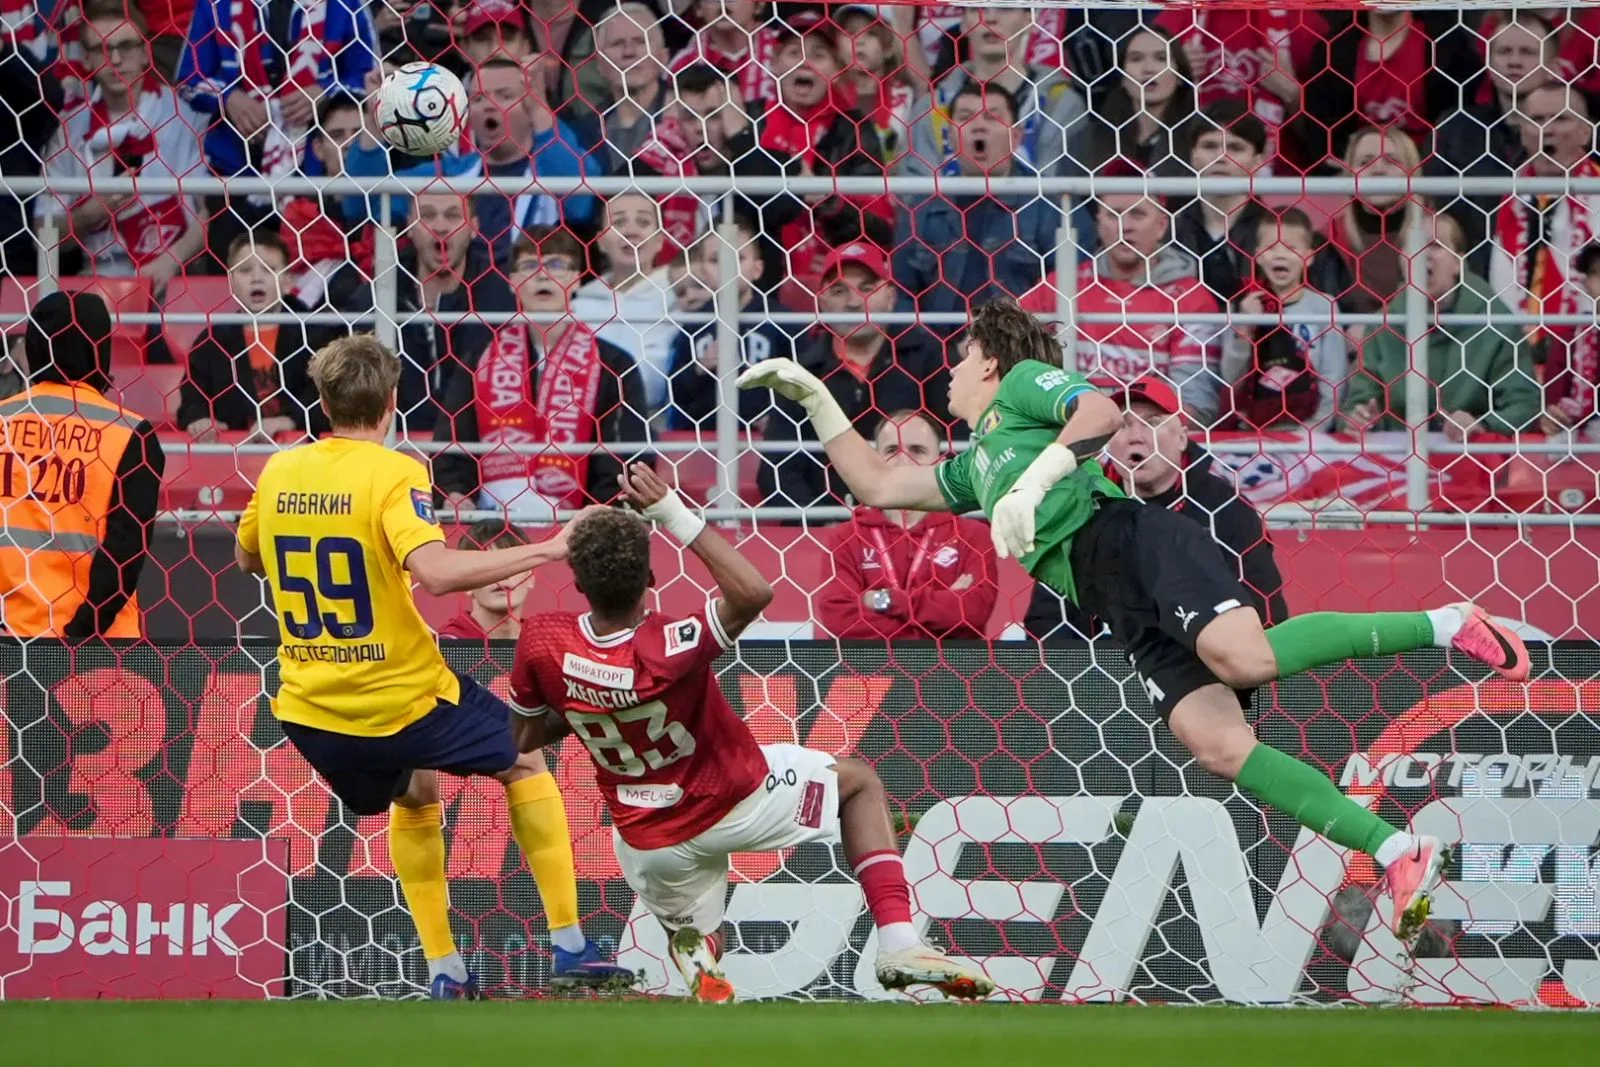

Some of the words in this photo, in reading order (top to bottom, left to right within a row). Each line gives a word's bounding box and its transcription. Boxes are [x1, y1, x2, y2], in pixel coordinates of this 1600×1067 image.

[490, 324, 523, 408] ОСКВА
[0, 420, 101, 453] STEWARD
[276, 492, 352, 516] БАБАКИН
[274, 535, 375, 640] 59
[569, 660, 626, 683] МИРАТОРГ
[564, 700, 697, 777] 83
[1339, 752, 1600, 790] МОТОРН
[18, 881, 244, 955] Банк
